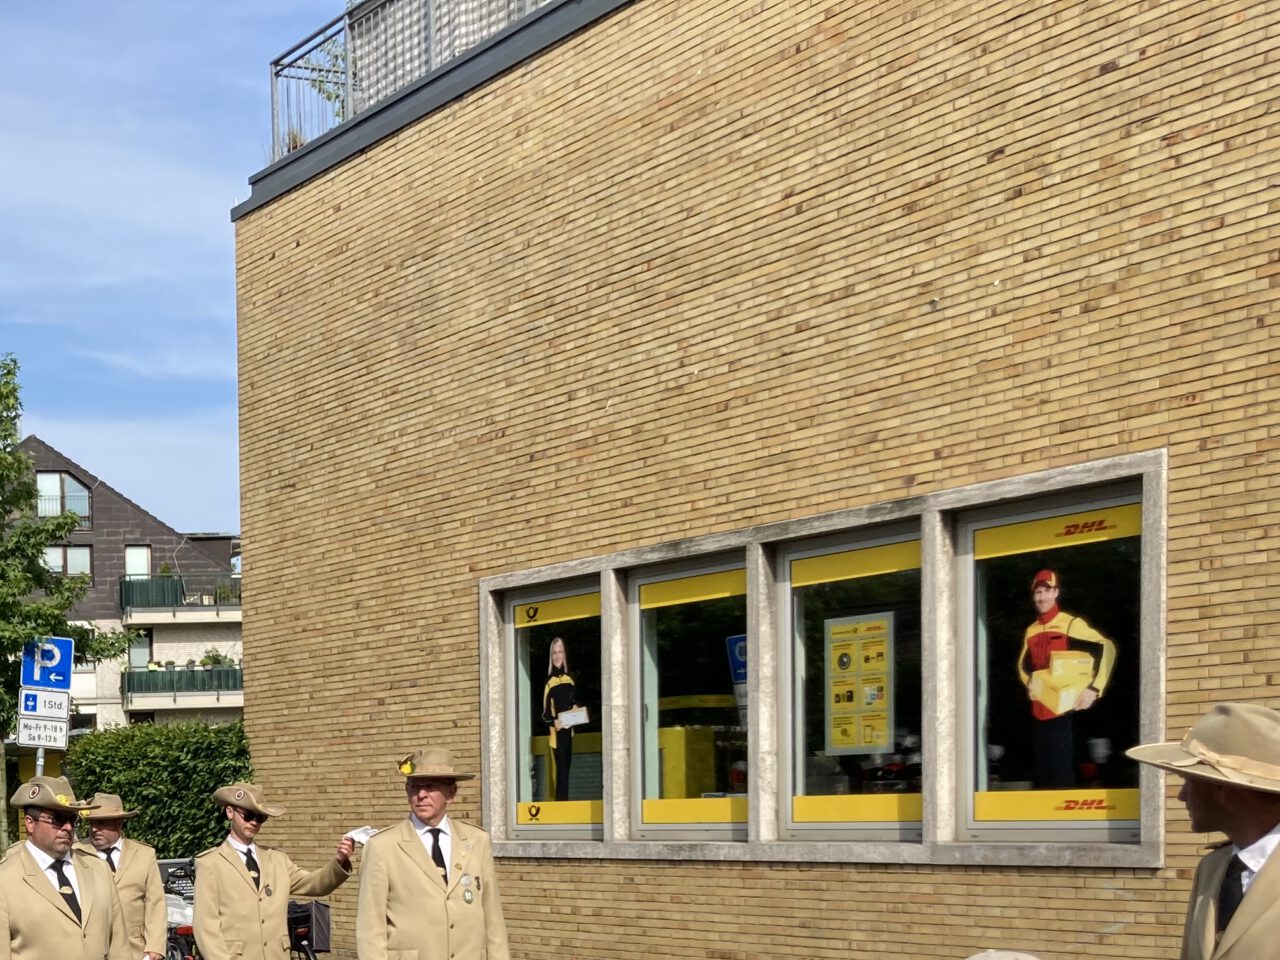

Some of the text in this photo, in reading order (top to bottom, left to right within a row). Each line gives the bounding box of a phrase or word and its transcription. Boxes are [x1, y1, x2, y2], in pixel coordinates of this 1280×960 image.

[1064, 519, 1108, 535] DHL
[33, 643, 61, 681] P
[43, 724, 58, 733] 9-18
[27, 733, 36, 742] Sa
[37, 734, 52, 743] 9-13
